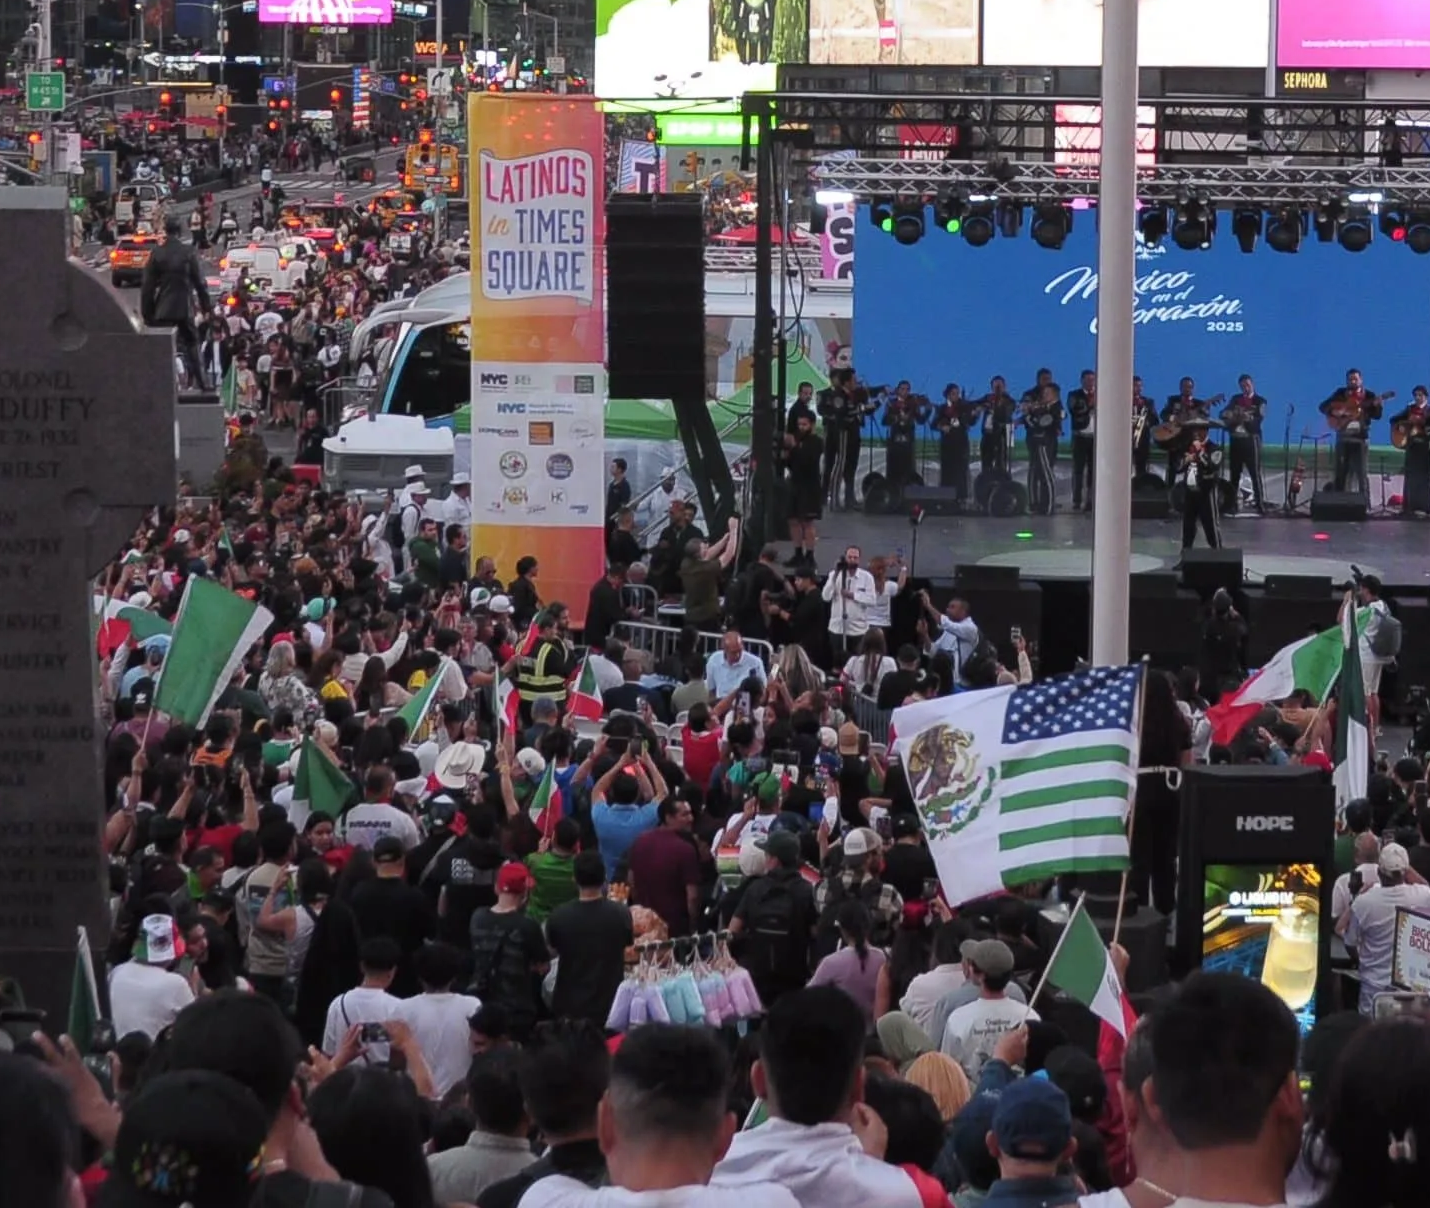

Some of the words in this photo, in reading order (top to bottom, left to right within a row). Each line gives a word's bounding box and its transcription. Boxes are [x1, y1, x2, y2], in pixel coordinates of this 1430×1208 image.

[1283, 72, 1328, 90] SEPHORA
[485, 155, 587, 205] LATINOS
[487, 214, 510, 236] in
[514, 208, 586, 245] TIMES
[488, 250, 586, 296] SQUARE
[1044, 265, 1196, 305] Mxico
[1206, 321, 1244, 332] 2025
[480, 373, 509, 386] NYC
[1236, 816, 1294, 831] HOPE
